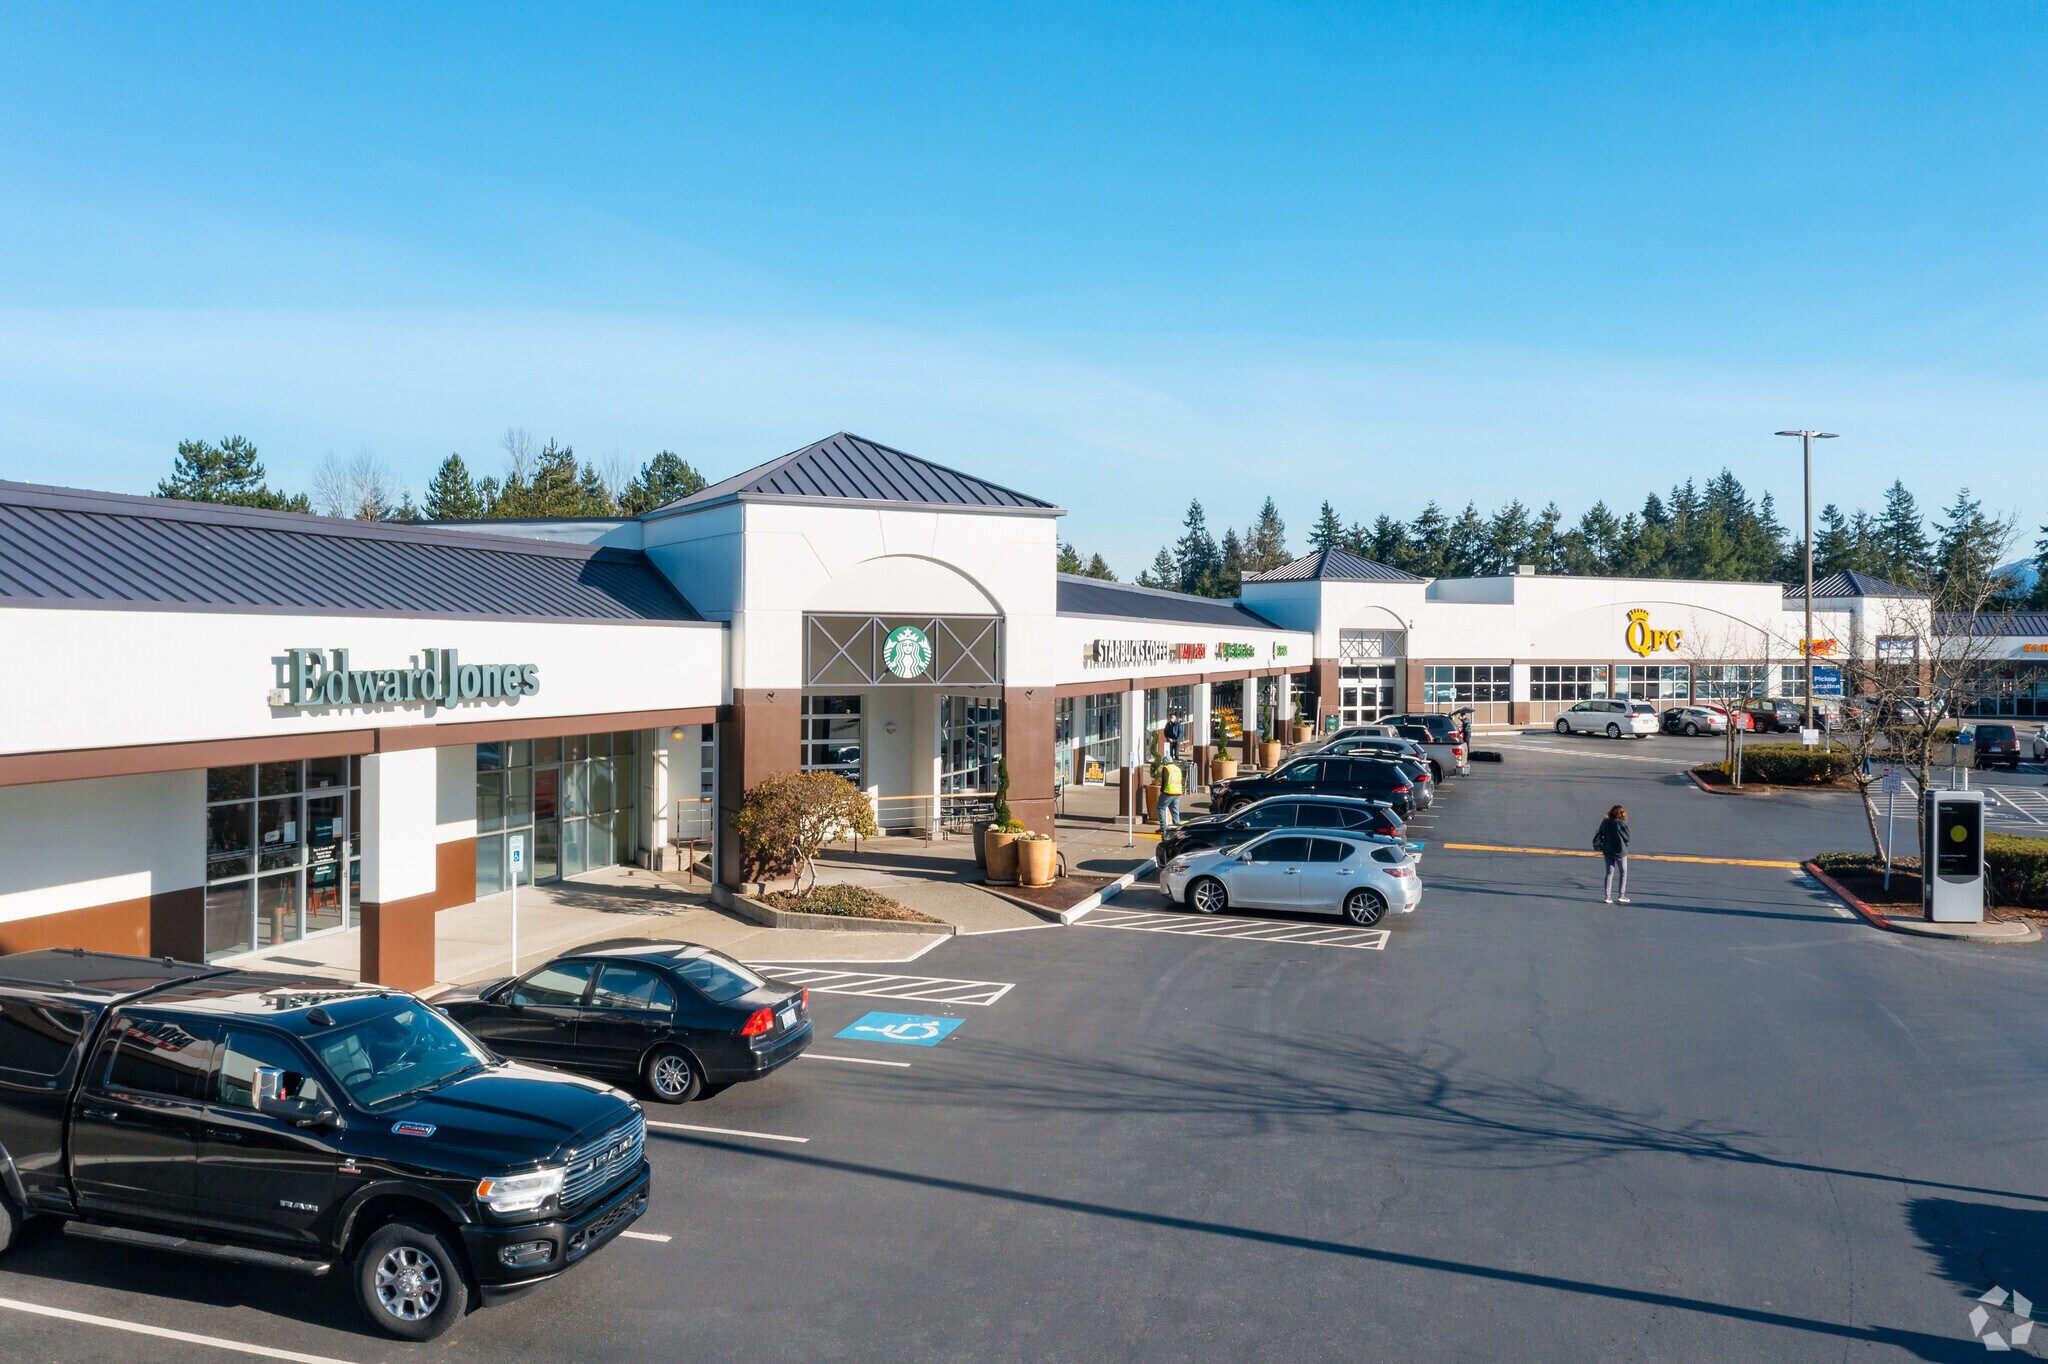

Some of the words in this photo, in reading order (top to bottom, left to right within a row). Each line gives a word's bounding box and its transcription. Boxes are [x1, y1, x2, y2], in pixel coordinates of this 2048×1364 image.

[1096, 639, 1146, 662] STARBUCKS
[596, 1135, 633, 1168] RAM
[280, 1200, 319, 1212] RAM
